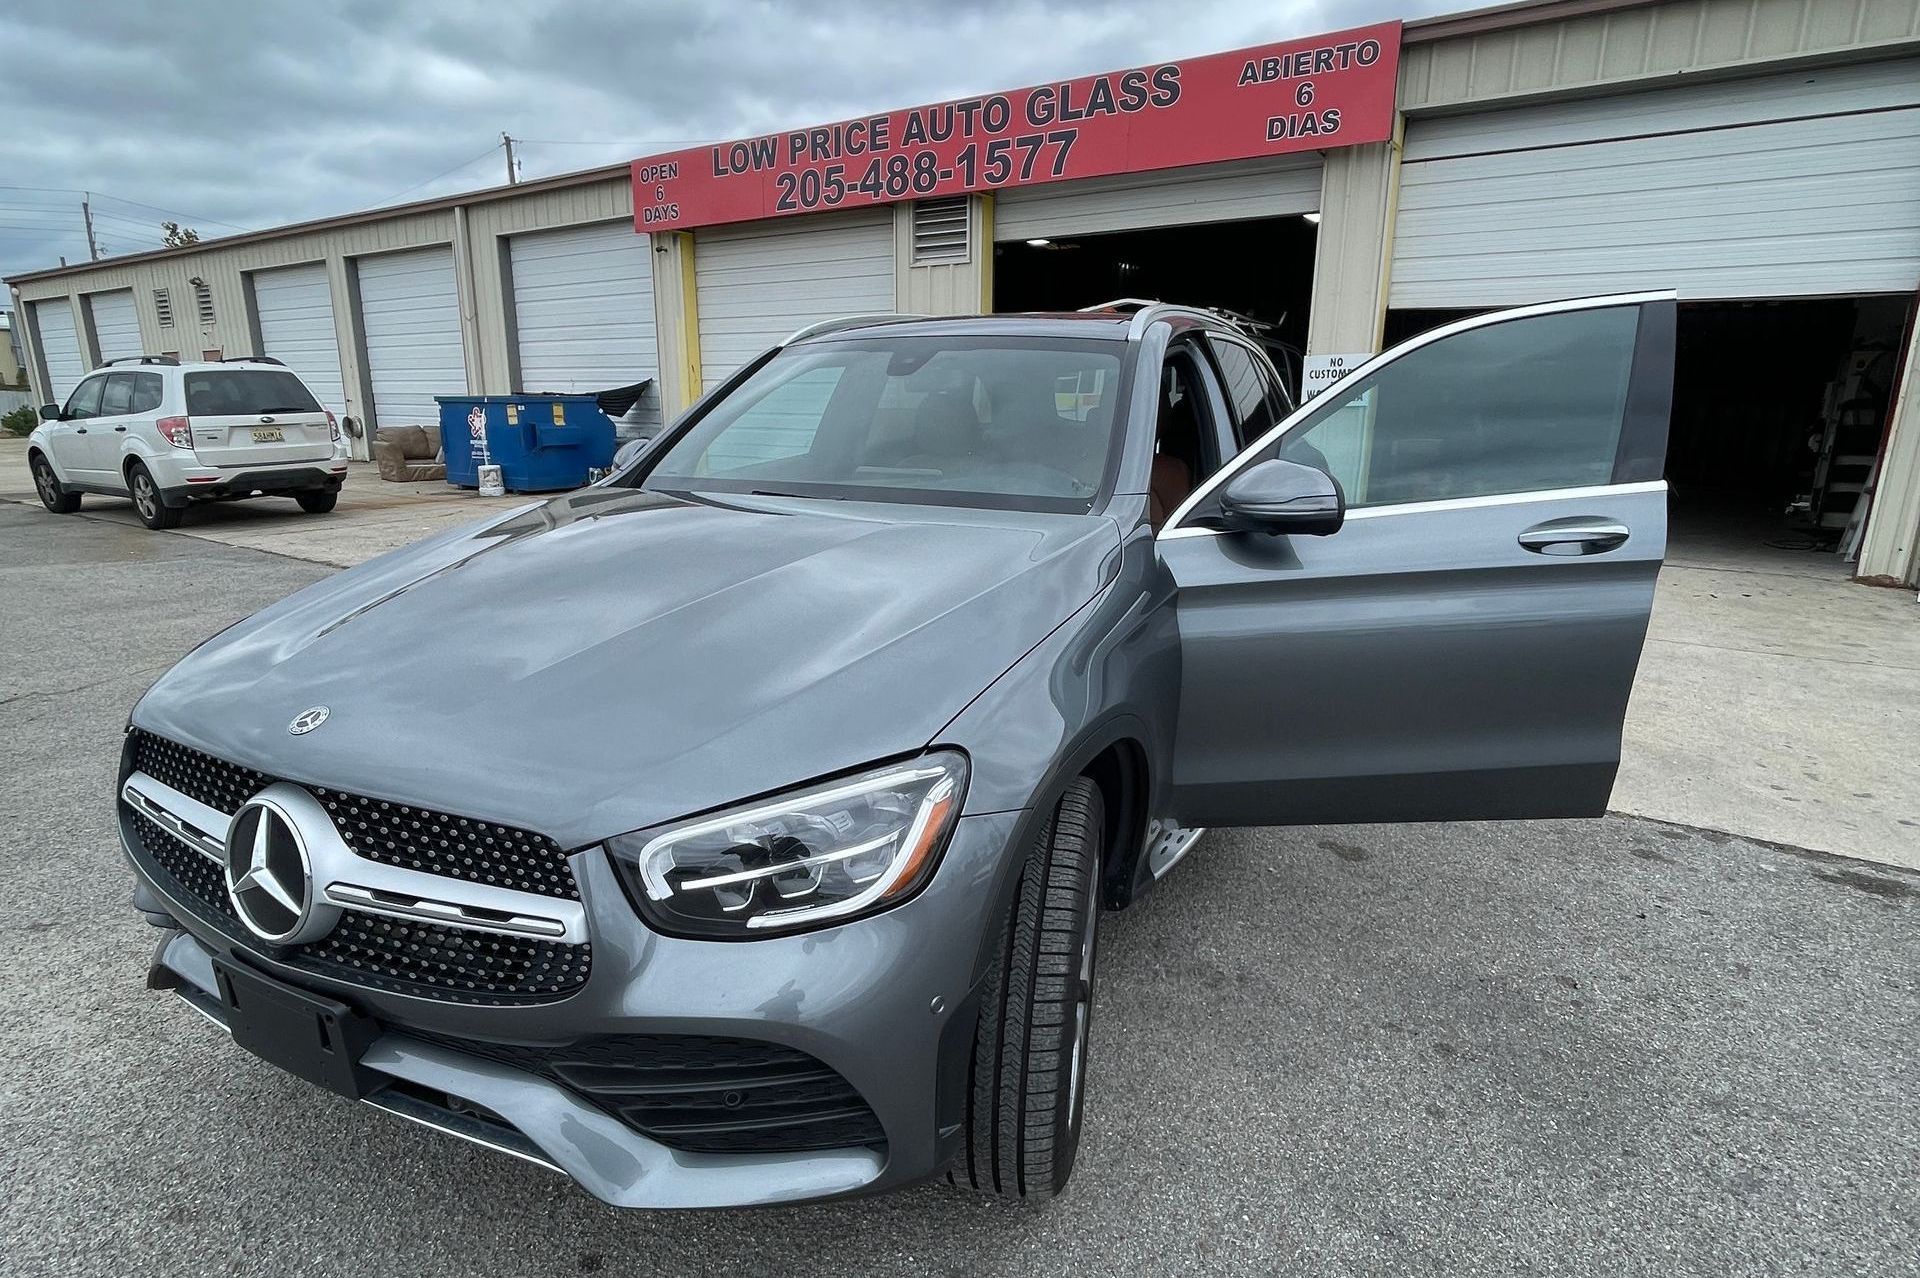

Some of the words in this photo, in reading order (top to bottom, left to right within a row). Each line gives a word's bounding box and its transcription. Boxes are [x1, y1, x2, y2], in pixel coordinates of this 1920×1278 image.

[1237, 39, 1381, 87] ABIERTO
[1295, 81, 1315, 107] 6
[712, 136, 779, 177] LOW
[789, 116, 890, 166] PRICE
[901, 96, 1011, 148] AUTO
[1025, 64, 1181, 127] GLASS
[1266, 109, 1341, 142] DIAS
[640, 162, 678, 184] OPEN
[776, 128, 1078, 212] 205-488-1577
[656, 184, 664, 202] 6
[643, 203, 679, 224] DAYS
[1330, 358, 1343, 367] NO
